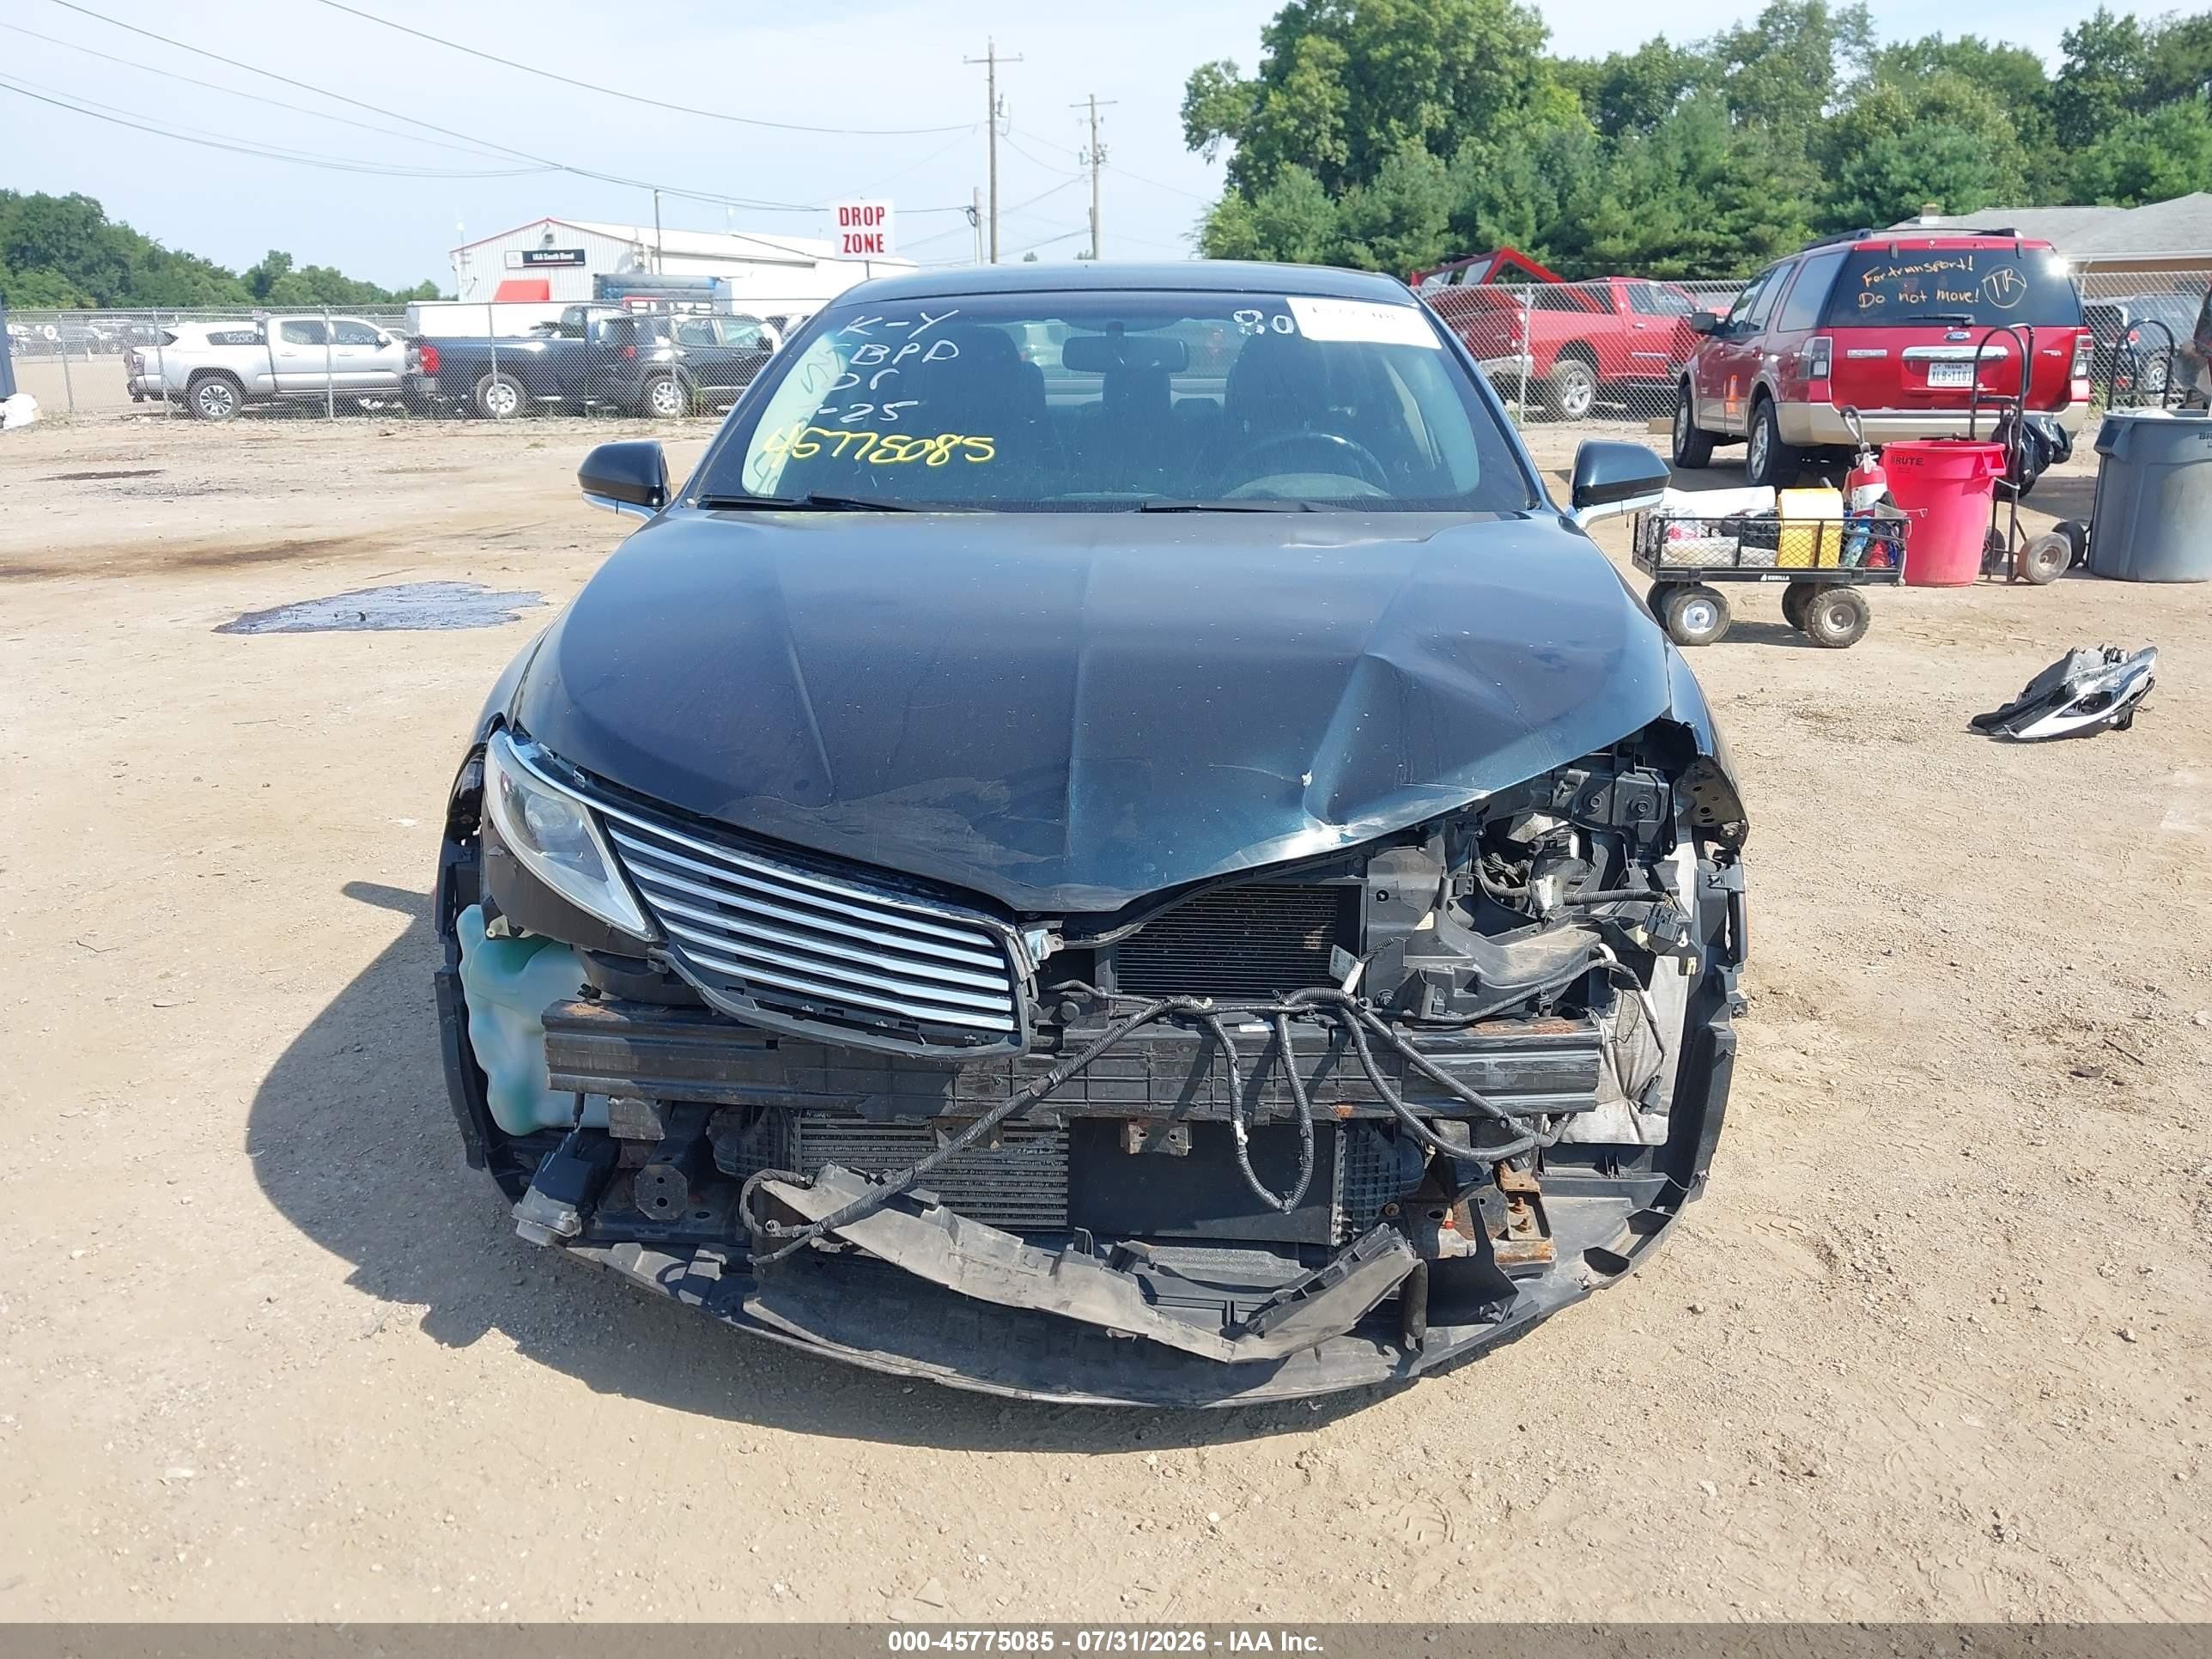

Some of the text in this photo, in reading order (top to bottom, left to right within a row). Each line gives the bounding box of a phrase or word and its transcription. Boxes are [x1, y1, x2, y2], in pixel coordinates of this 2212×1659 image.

[839, 206, 884, 226] DROP
[842, 233, 884, 253] ZONE
[1858, 293, 1886, 308] Do
[1899, 289, 1928, 304] not
[1891, 455, 1924, 466] BRUTE
